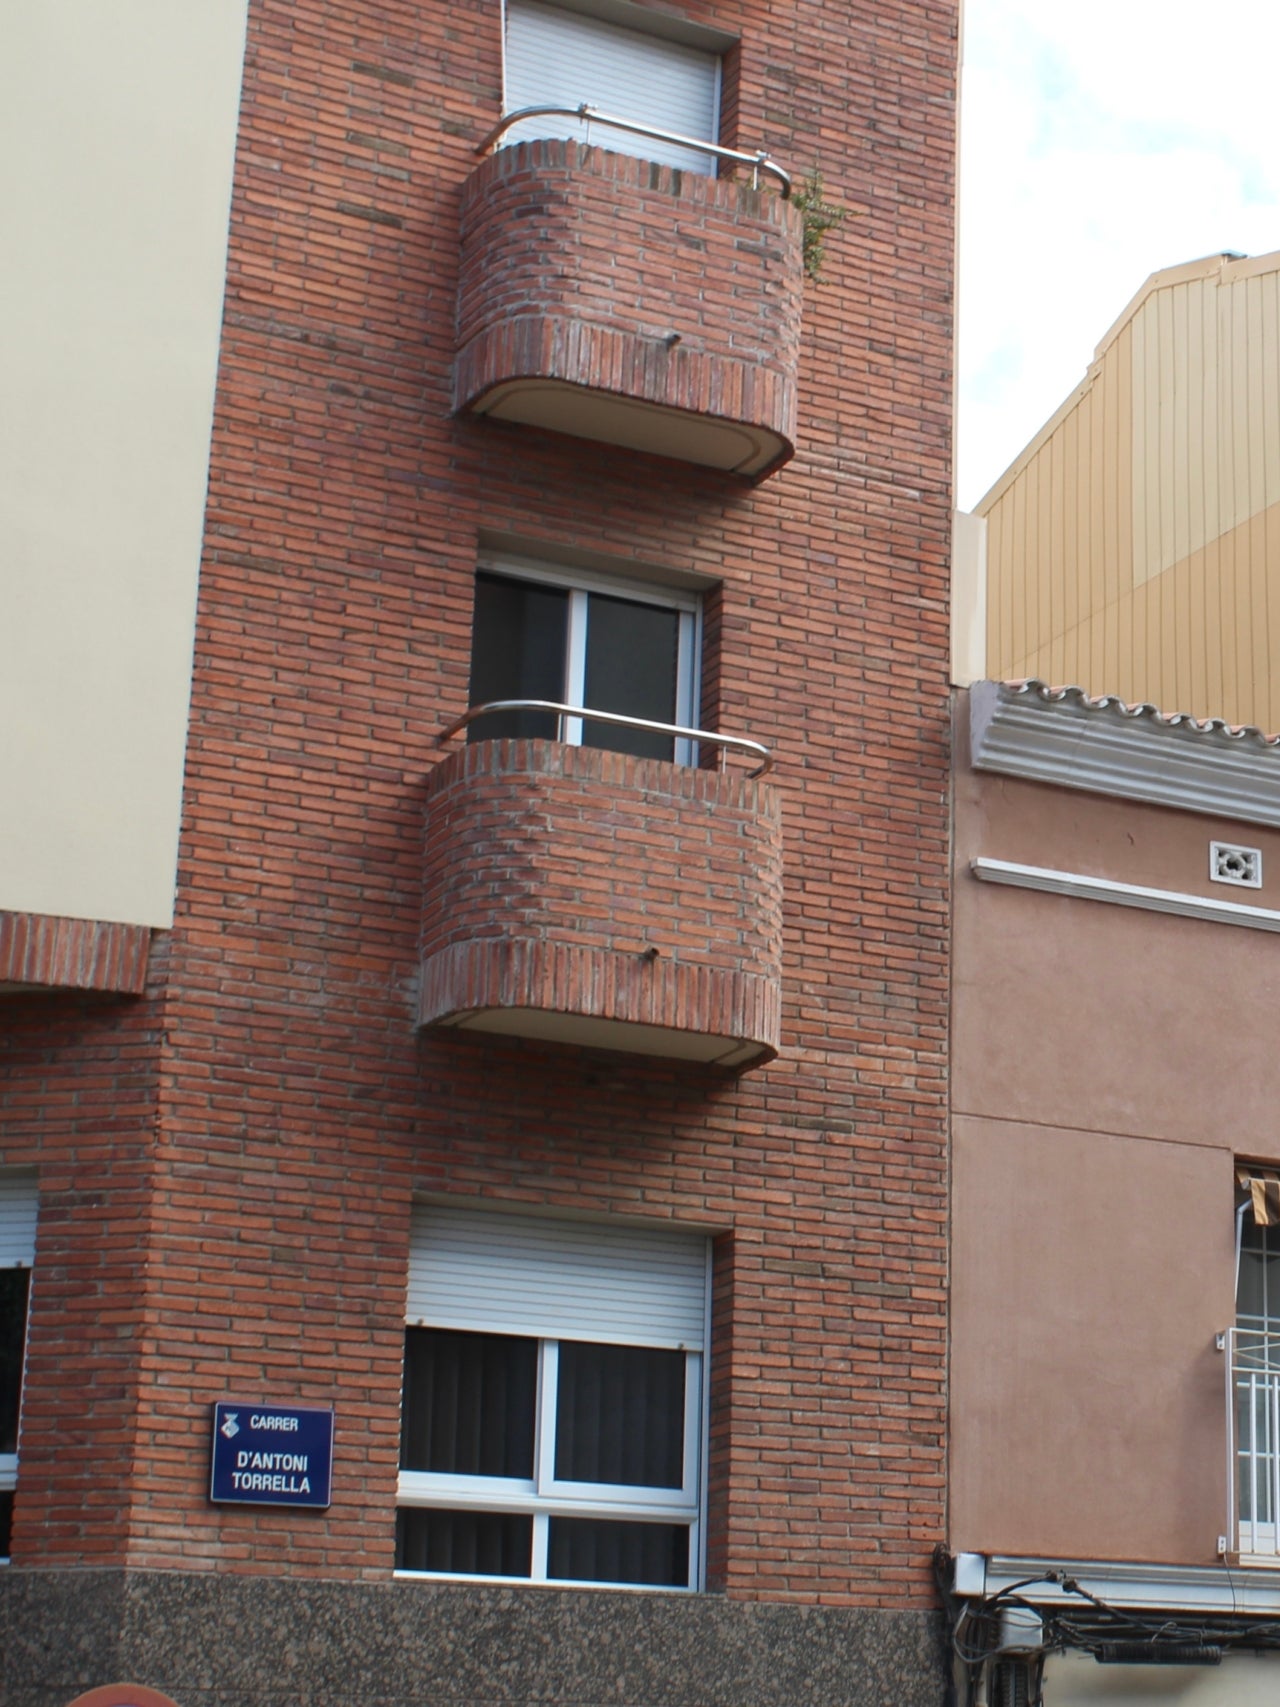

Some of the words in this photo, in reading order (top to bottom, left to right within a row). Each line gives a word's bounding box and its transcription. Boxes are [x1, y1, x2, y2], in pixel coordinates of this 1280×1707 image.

[250, 1414, 298, 1431] CARRER
[237, 1451, 308, 1472] D'ANTONI
[232, 1472, 310, 1493] TORRELLA
